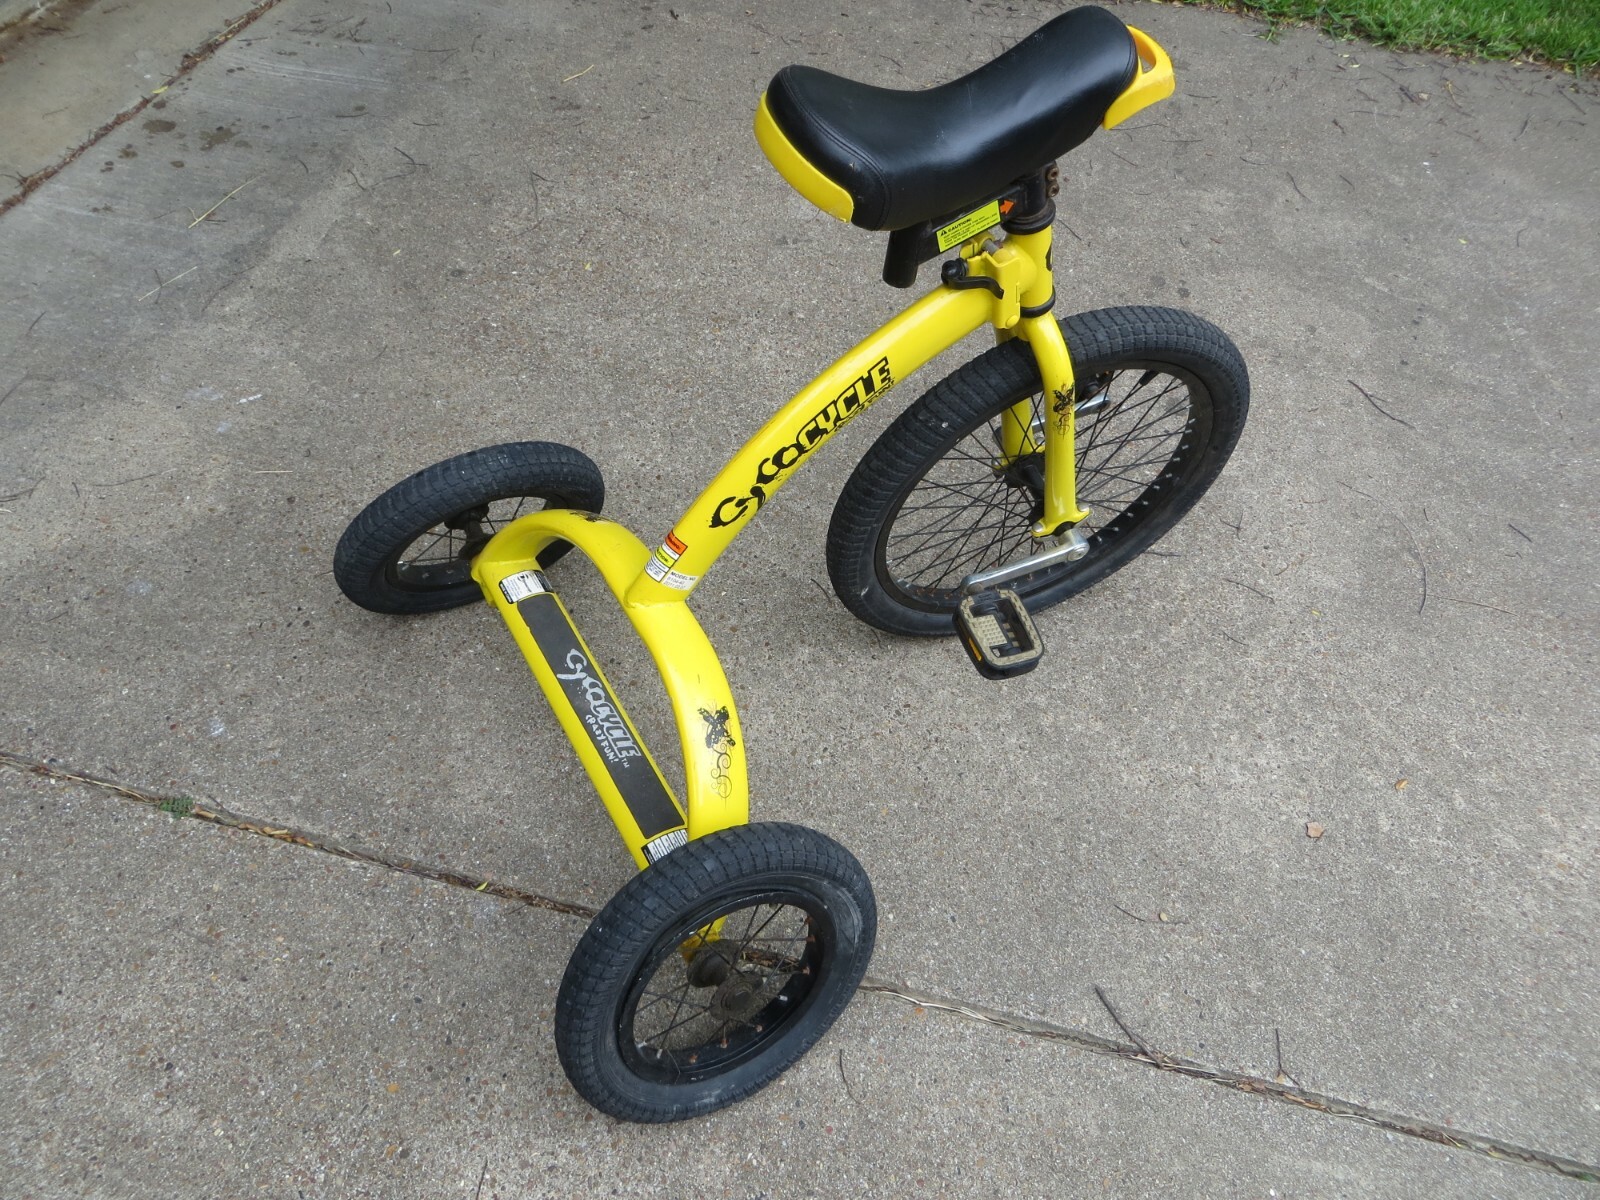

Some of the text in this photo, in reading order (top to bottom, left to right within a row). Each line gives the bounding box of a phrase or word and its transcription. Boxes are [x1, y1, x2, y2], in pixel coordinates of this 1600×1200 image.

[671, 571, 689, 581] MODEL
[585, 714, 619, 764] CRAZY FUN!
